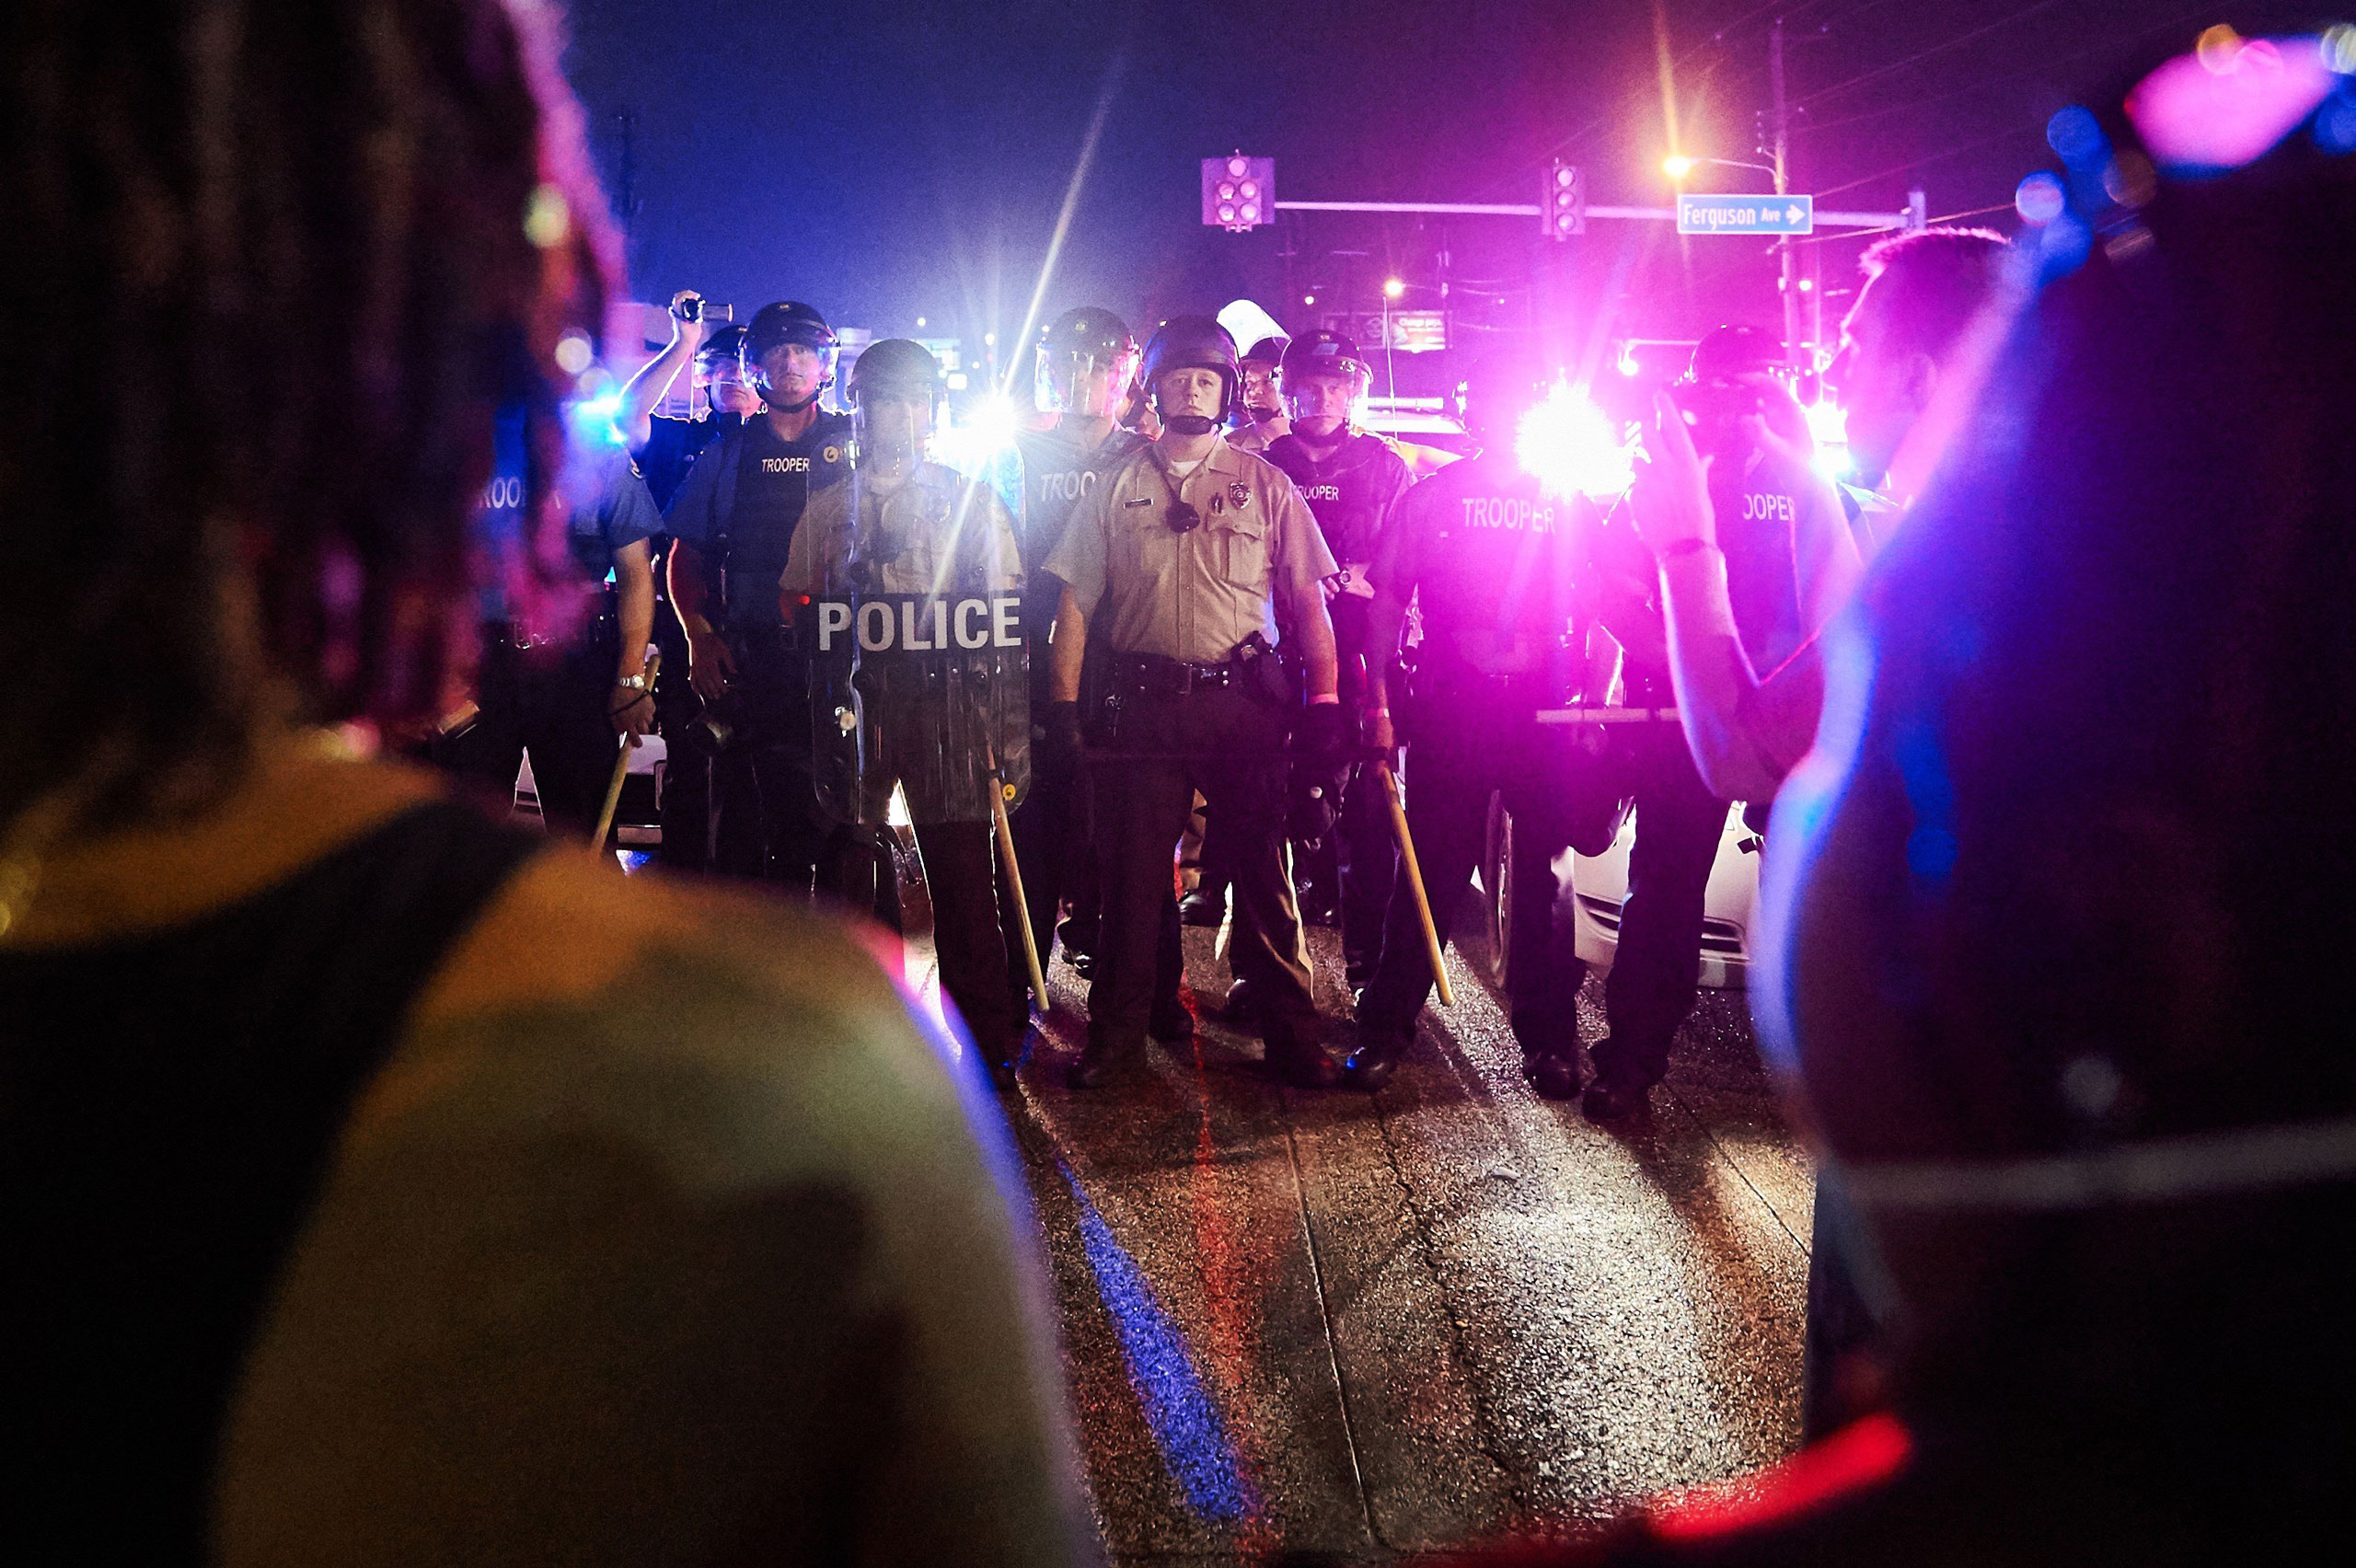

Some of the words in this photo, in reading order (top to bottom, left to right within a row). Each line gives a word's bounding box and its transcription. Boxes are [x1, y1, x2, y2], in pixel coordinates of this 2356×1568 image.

[1683, 203, 1756, 230] Ferguson
[1761, 207, 1781, 222] Ave
[761, 457, 810, 472] TROOPER
[1461, 497, 1555, 534] TROOPER
[819, 598, 1022, 651] POLICE
